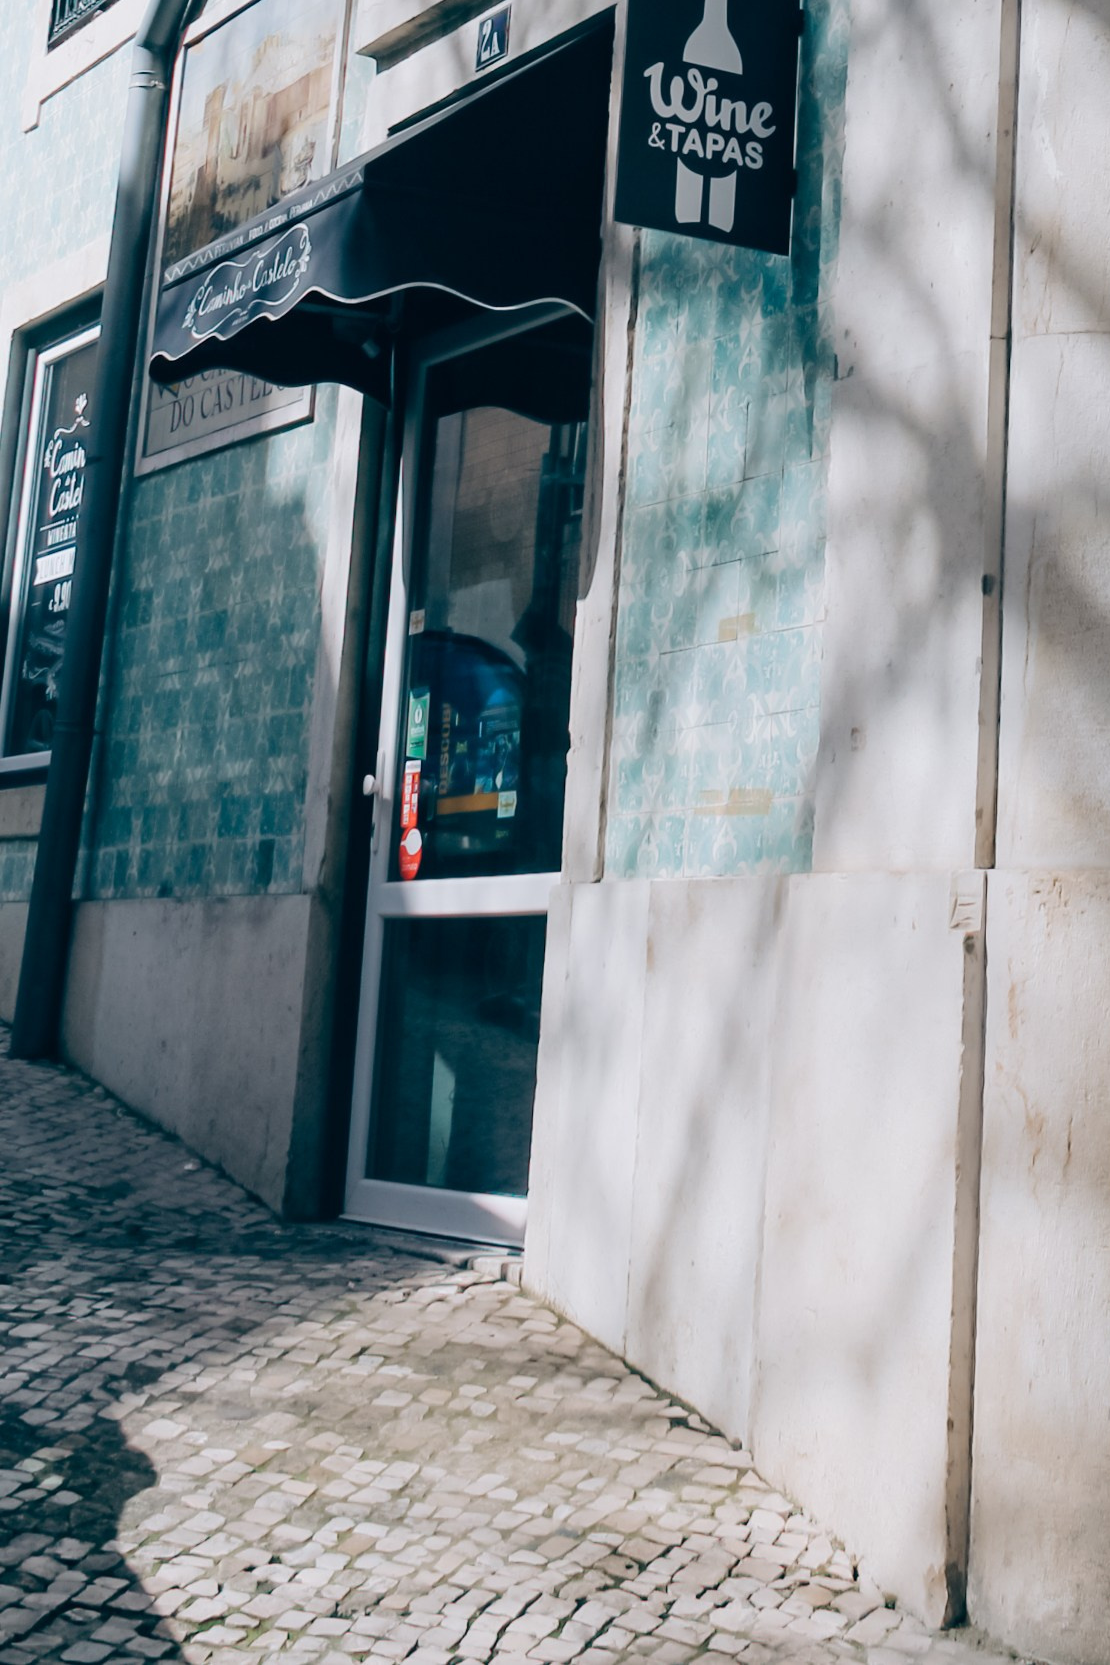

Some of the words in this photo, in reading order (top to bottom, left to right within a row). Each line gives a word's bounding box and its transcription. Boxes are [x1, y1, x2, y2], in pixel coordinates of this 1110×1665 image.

[643, 61, 777, 139] Wine
[199, 271, 246, 316] Caminho
[252, 246, 297, 292] Castelo
[170, 394, 195, 433] DO
[200, 374, 286, 419] CASTEL
